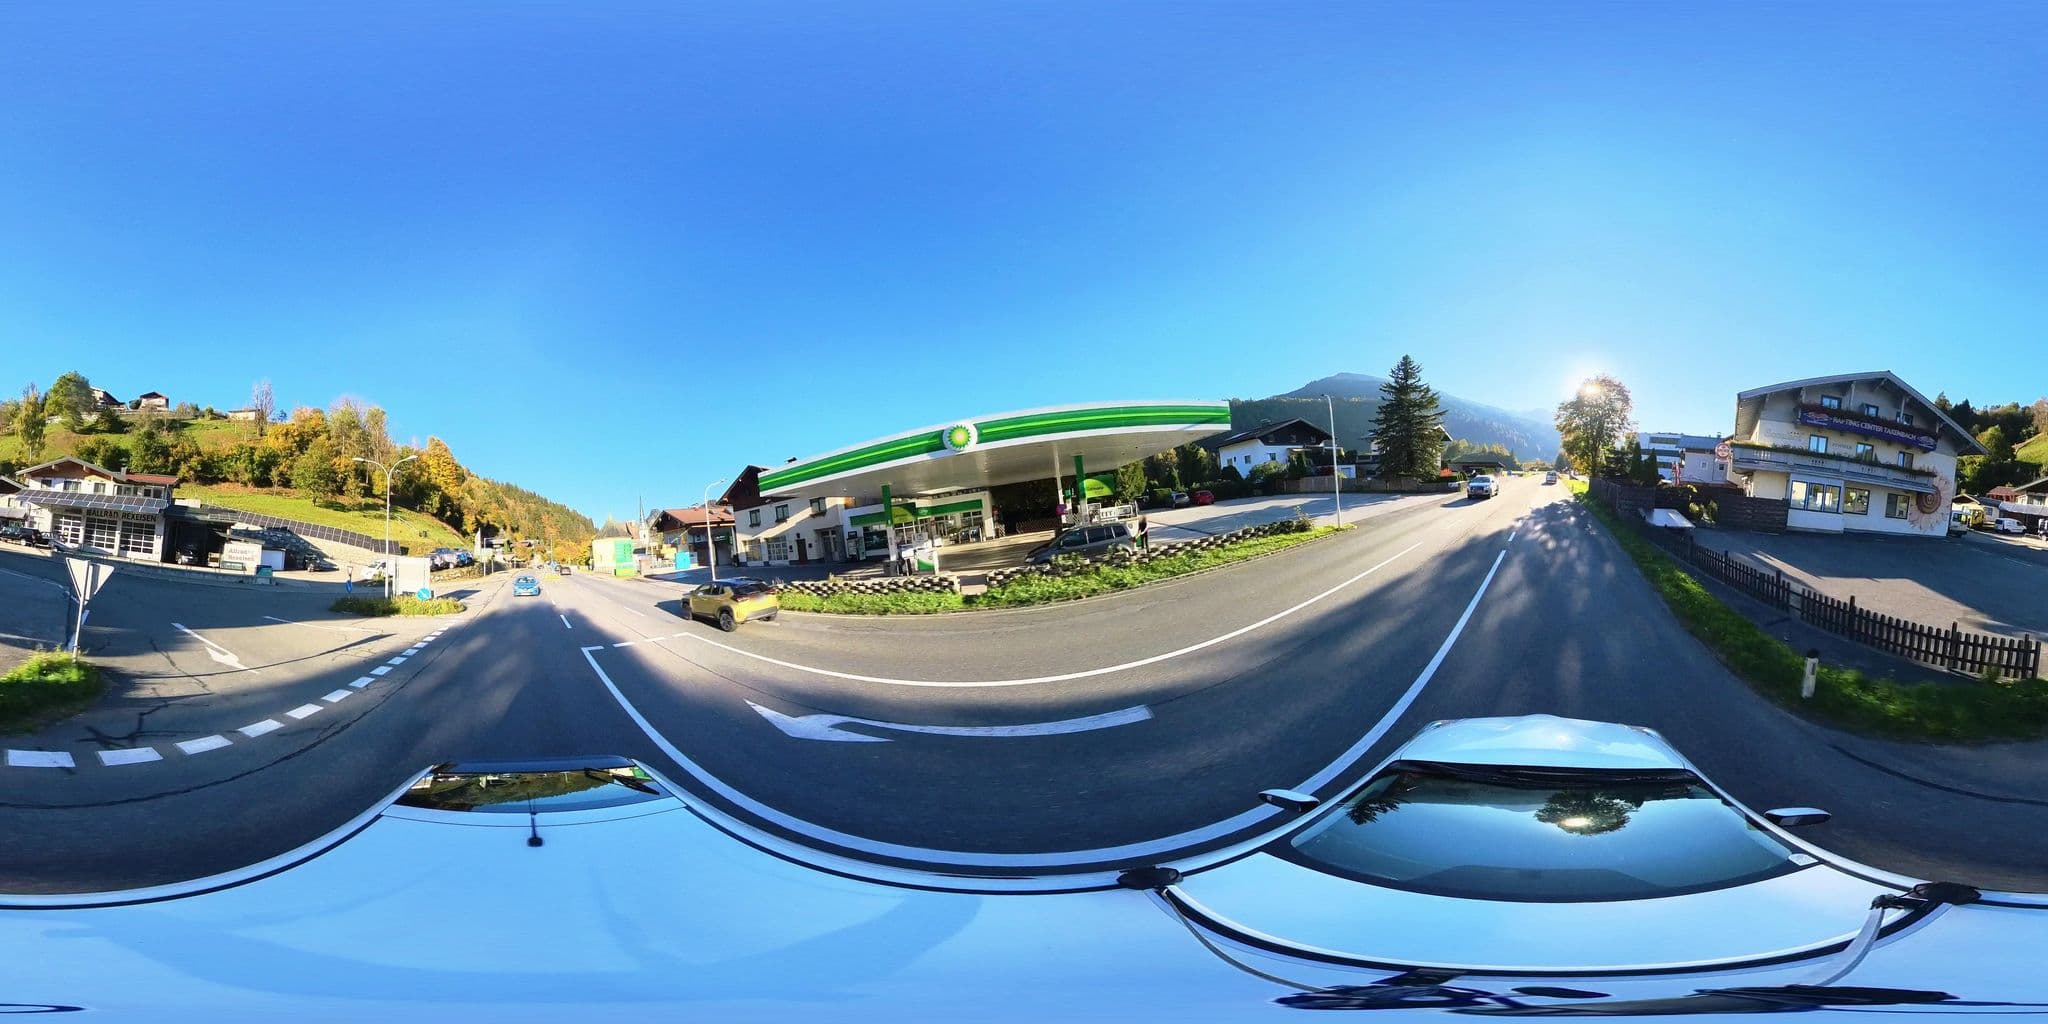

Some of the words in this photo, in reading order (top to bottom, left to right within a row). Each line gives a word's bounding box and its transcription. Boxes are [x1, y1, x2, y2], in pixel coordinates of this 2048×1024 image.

[1832, 417, 1860, 428] RAFTING
[1860, 422, 1883, 434] CENTER
[1883, 428, 1917, 441] TAXENBACH
[91, 509, 119, 519] ALLRAD
[122, 512, 157, 522] REXEISEN
